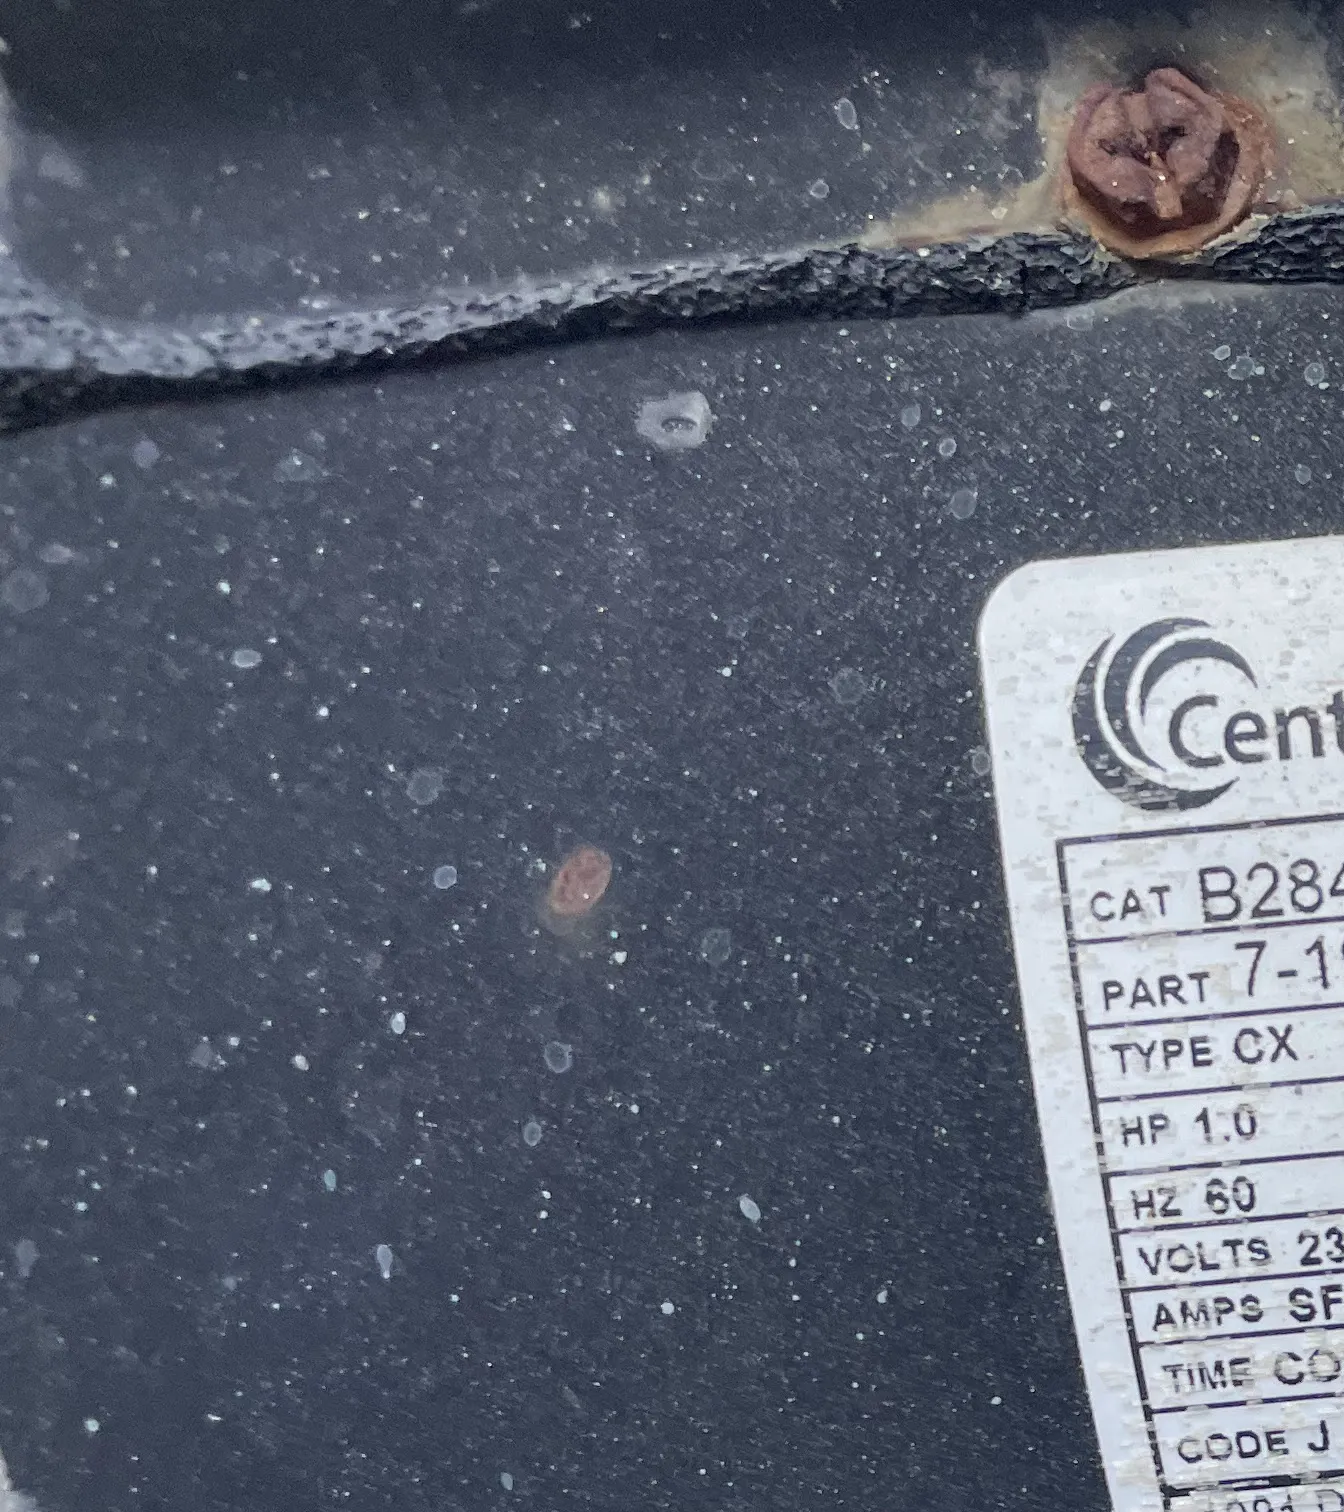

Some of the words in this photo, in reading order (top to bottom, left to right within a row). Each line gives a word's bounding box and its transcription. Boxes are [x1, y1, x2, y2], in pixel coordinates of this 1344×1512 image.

[1090, 884, 1171, 924] CAT
[1101, 970, 1211, 1012] PART
[1109, 1035, 1215, 1074] TYPE
[1232, 1023, 1300, 1066] CX
[1120, 1112, 1170, 1147] HP
[1194, 1102, 1258, 1144] 1.0
[1130, 1187, 1182, 1220] HZ
[1204, 1175, 1258, 1217] 60
[1137, 1236, 1273, 1277] VOLTS
[1152, 1293, 1264, 1333] AMPS
[1288, 1283, 1344, 1323] SF
[1161, 1357, 1252, 1391] TIME
[1177, 1430, 1290, 1465] CODE
[1306, 1419, 1331, 1453] J
